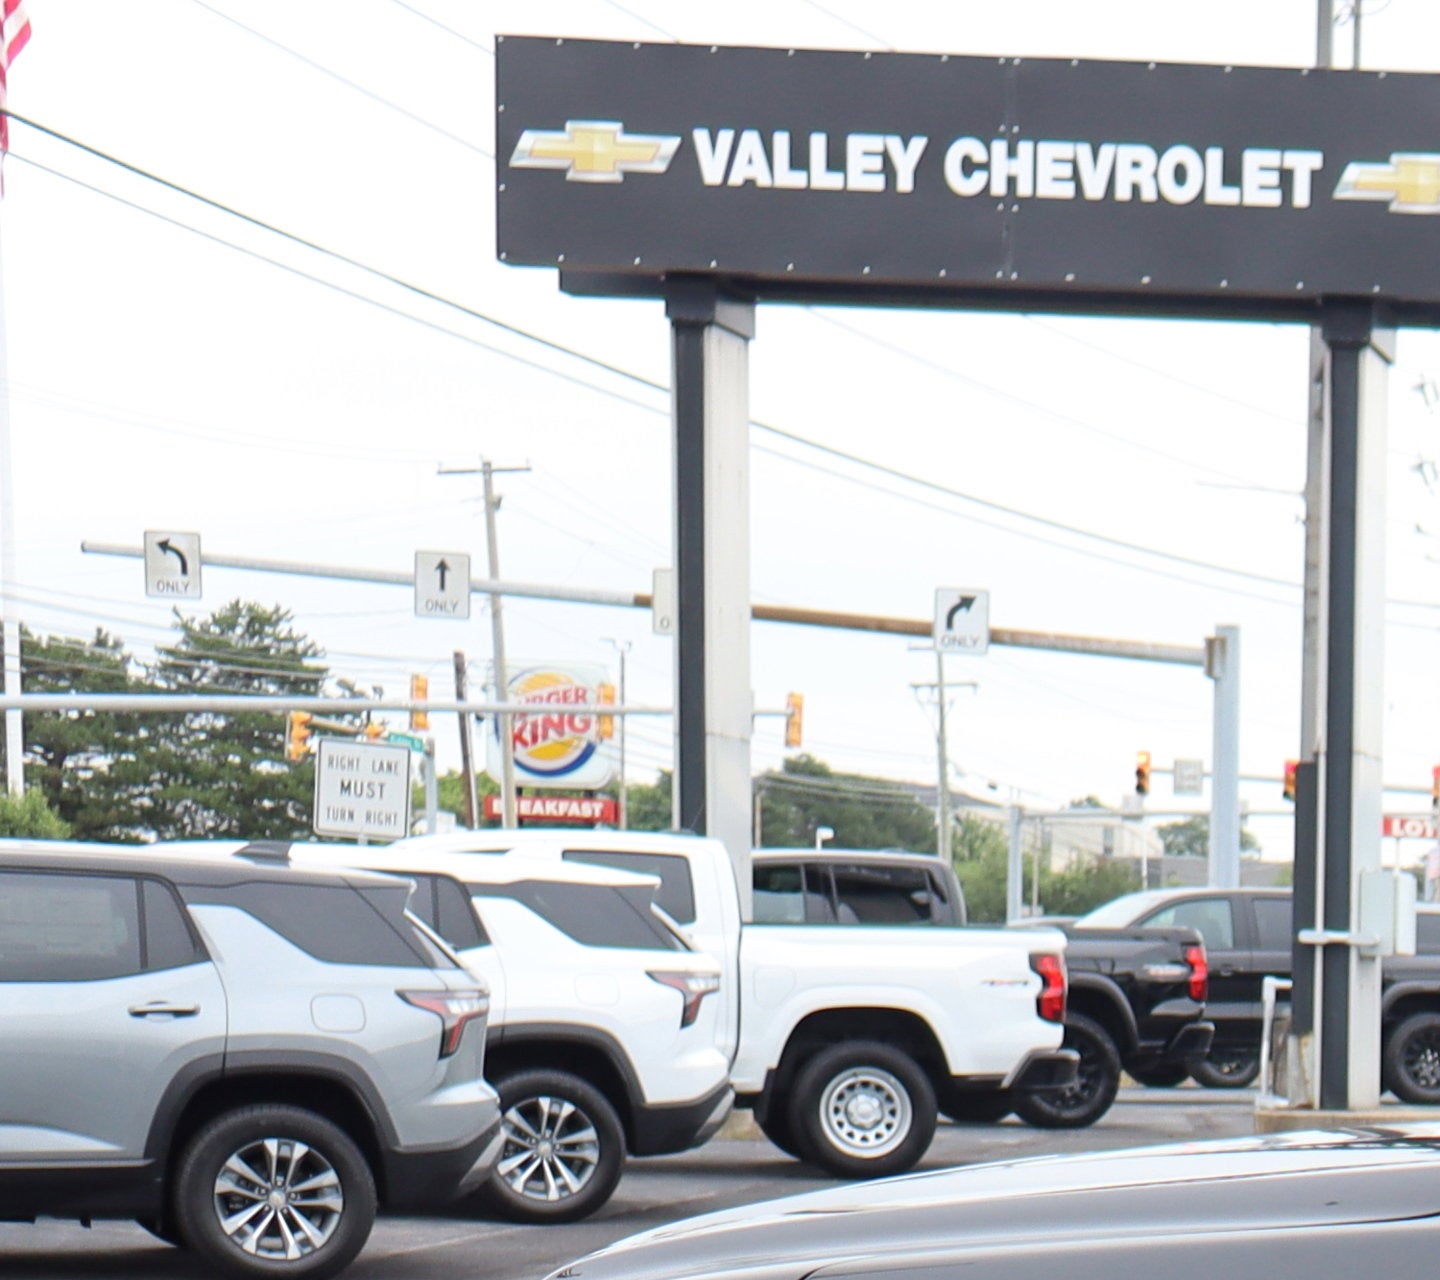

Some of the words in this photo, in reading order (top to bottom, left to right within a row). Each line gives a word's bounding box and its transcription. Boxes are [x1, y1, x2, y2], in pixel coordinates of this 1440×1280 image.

[693, 128, 928, 193] VALLEY
[943, 137, 1324, 208] CHEVROLET
[156, 580, 190, 594] ONLY
[425, 598, 459, 614] ONLY
[940, 633, 979, 650] ONLY
[328, 754, 360, 771] RIGHT
[372, 759, 399, 776] LANE
[340, 778, 386, 800] MUST
[326, 805, 355, 823] TURN
[365, 810, 398, 827] RIGHT
[492, 798, 604, 818] BEAKFAST
